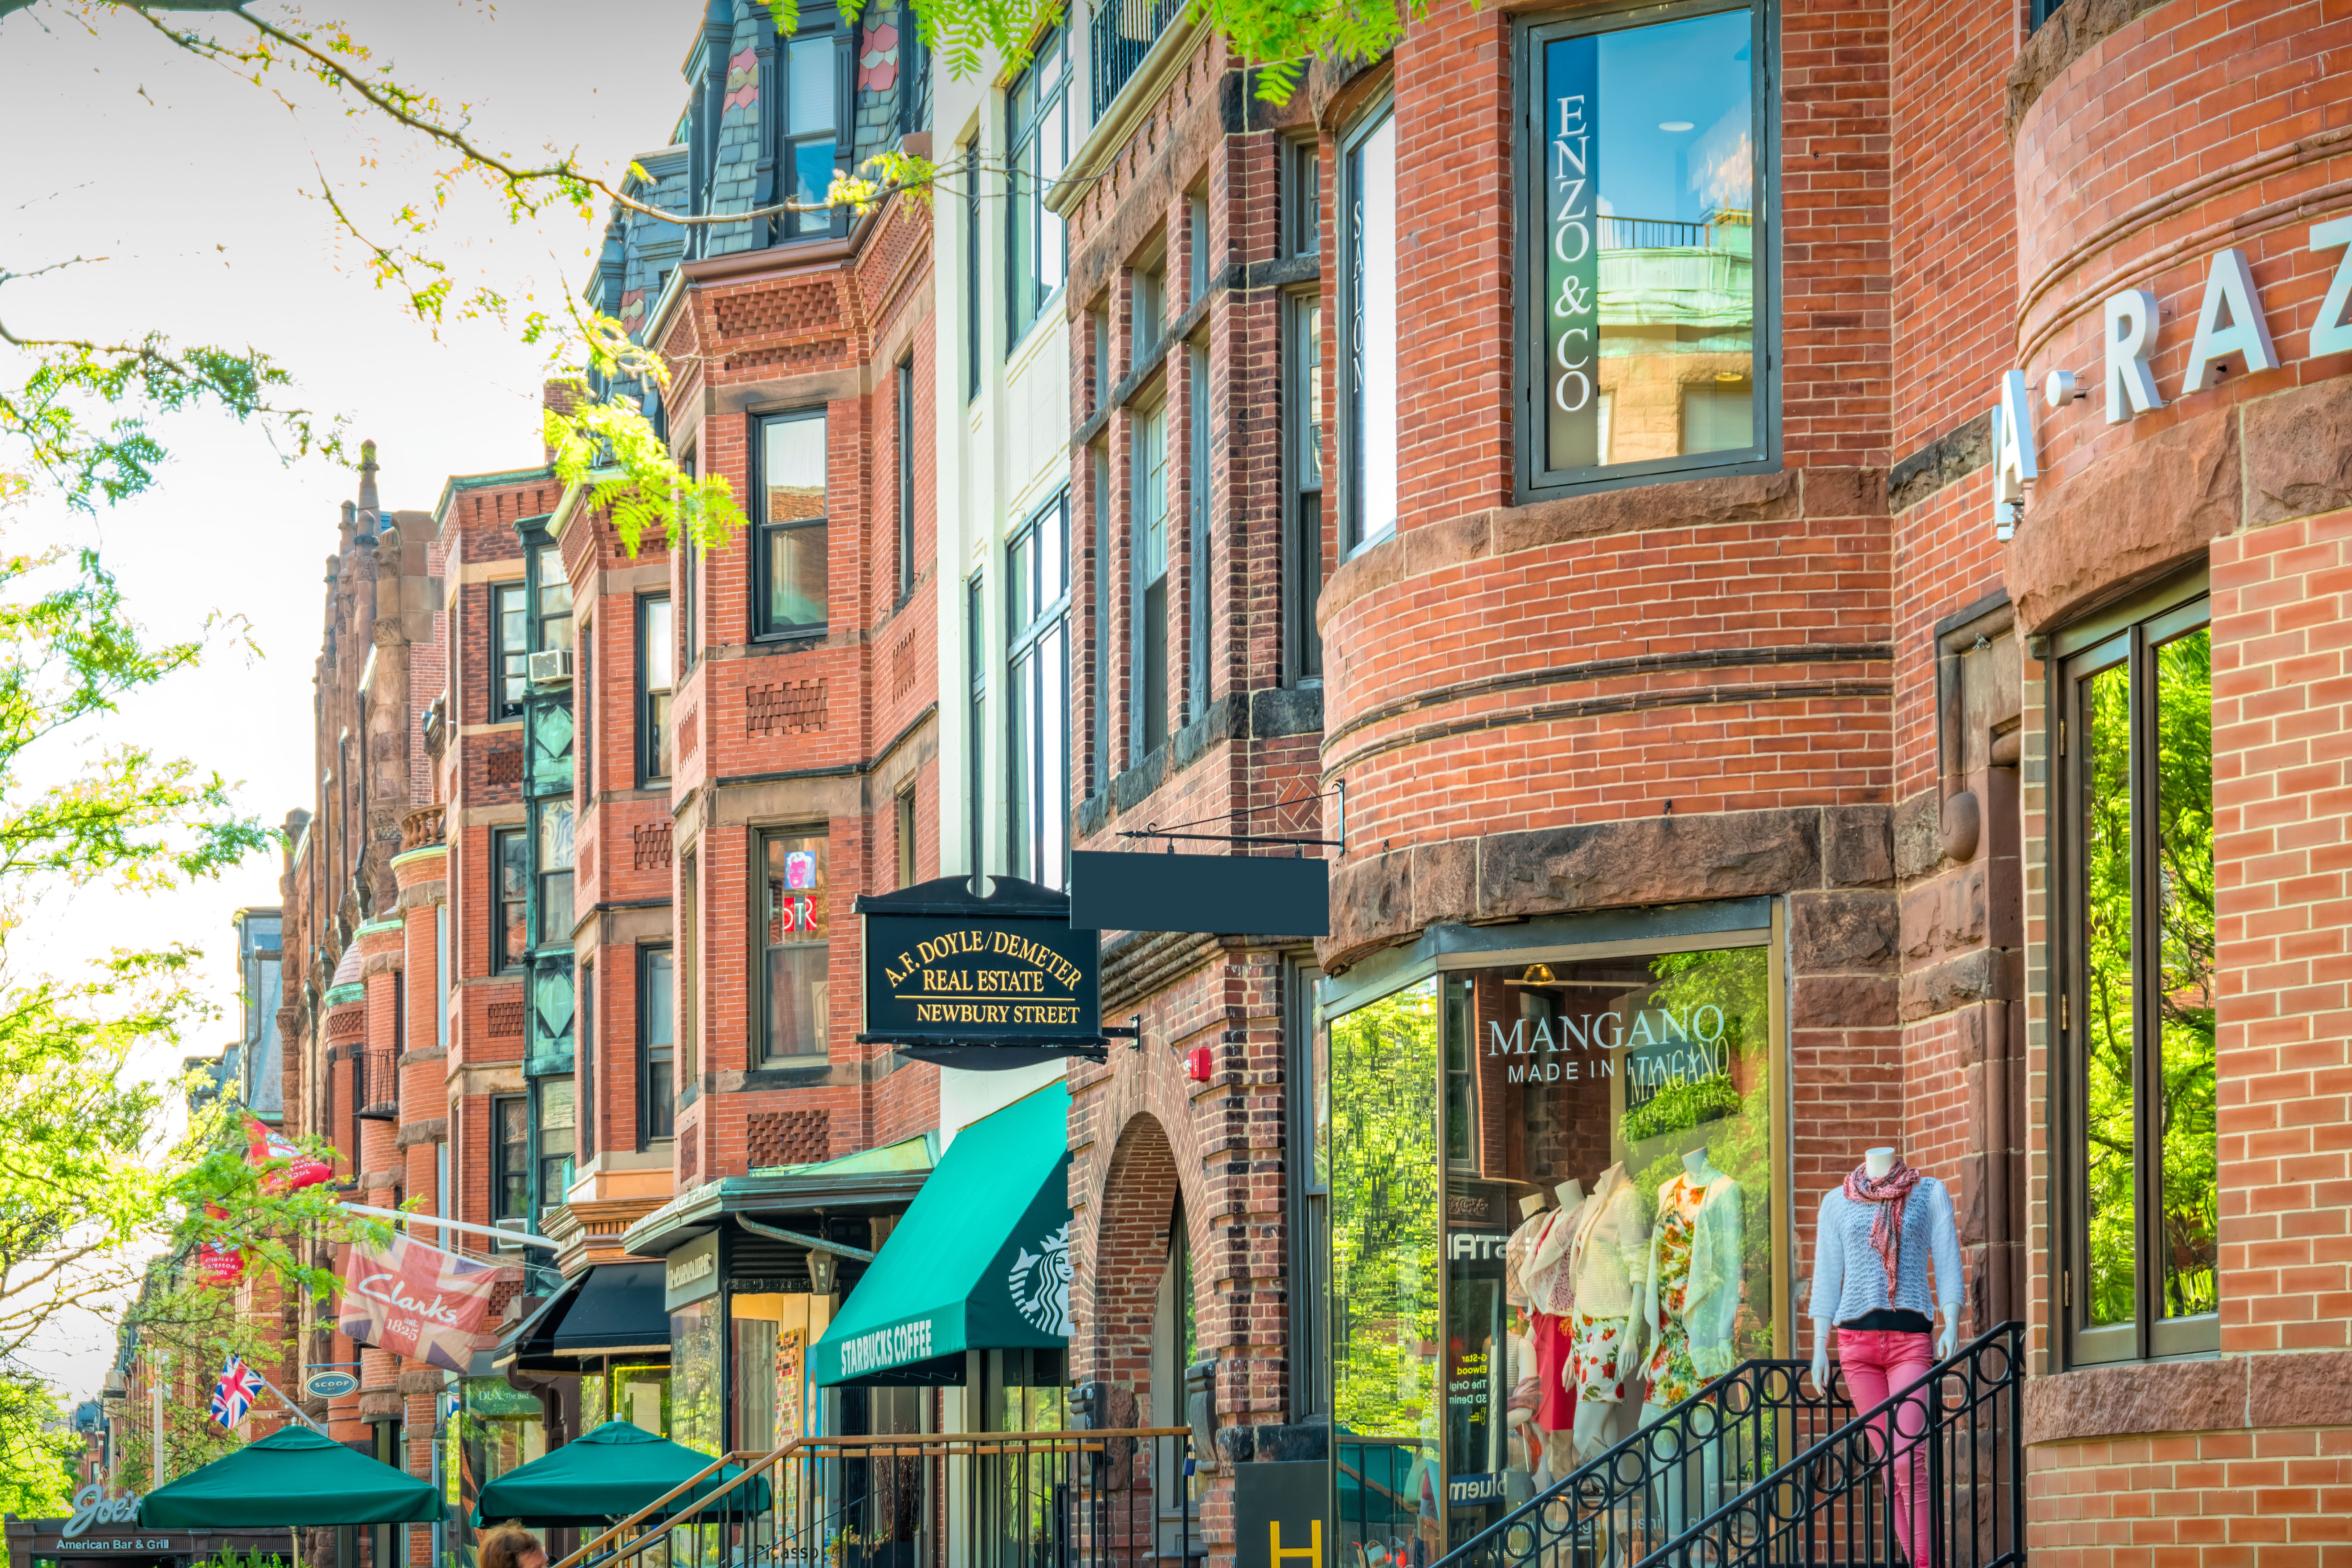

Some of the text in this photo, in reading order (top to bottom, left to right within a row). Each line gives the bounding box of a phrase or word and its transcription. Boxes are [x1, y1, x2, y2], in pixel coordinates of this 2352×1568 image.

[1553, 94, 1591, 413] ENZO & CO
[1353, 199, 1364, 393] SALON
[885, 951, 920, 988] A.F.
[923, 969, 1044, 992] REAL ESTATE
[917, 1004, 1080, 1024] NEWBURY STREET
[1487, 1005, 1724, 1056] MANGANO
[1509, 1053, 1701, 1083] MADE IN ITALY
[385, 1318, 419, 1341] 1825
[841, 1319, 932, 1377] STARBUCKS COFFEE
[56, 1539, 169, 1550] American Bar & Grill
